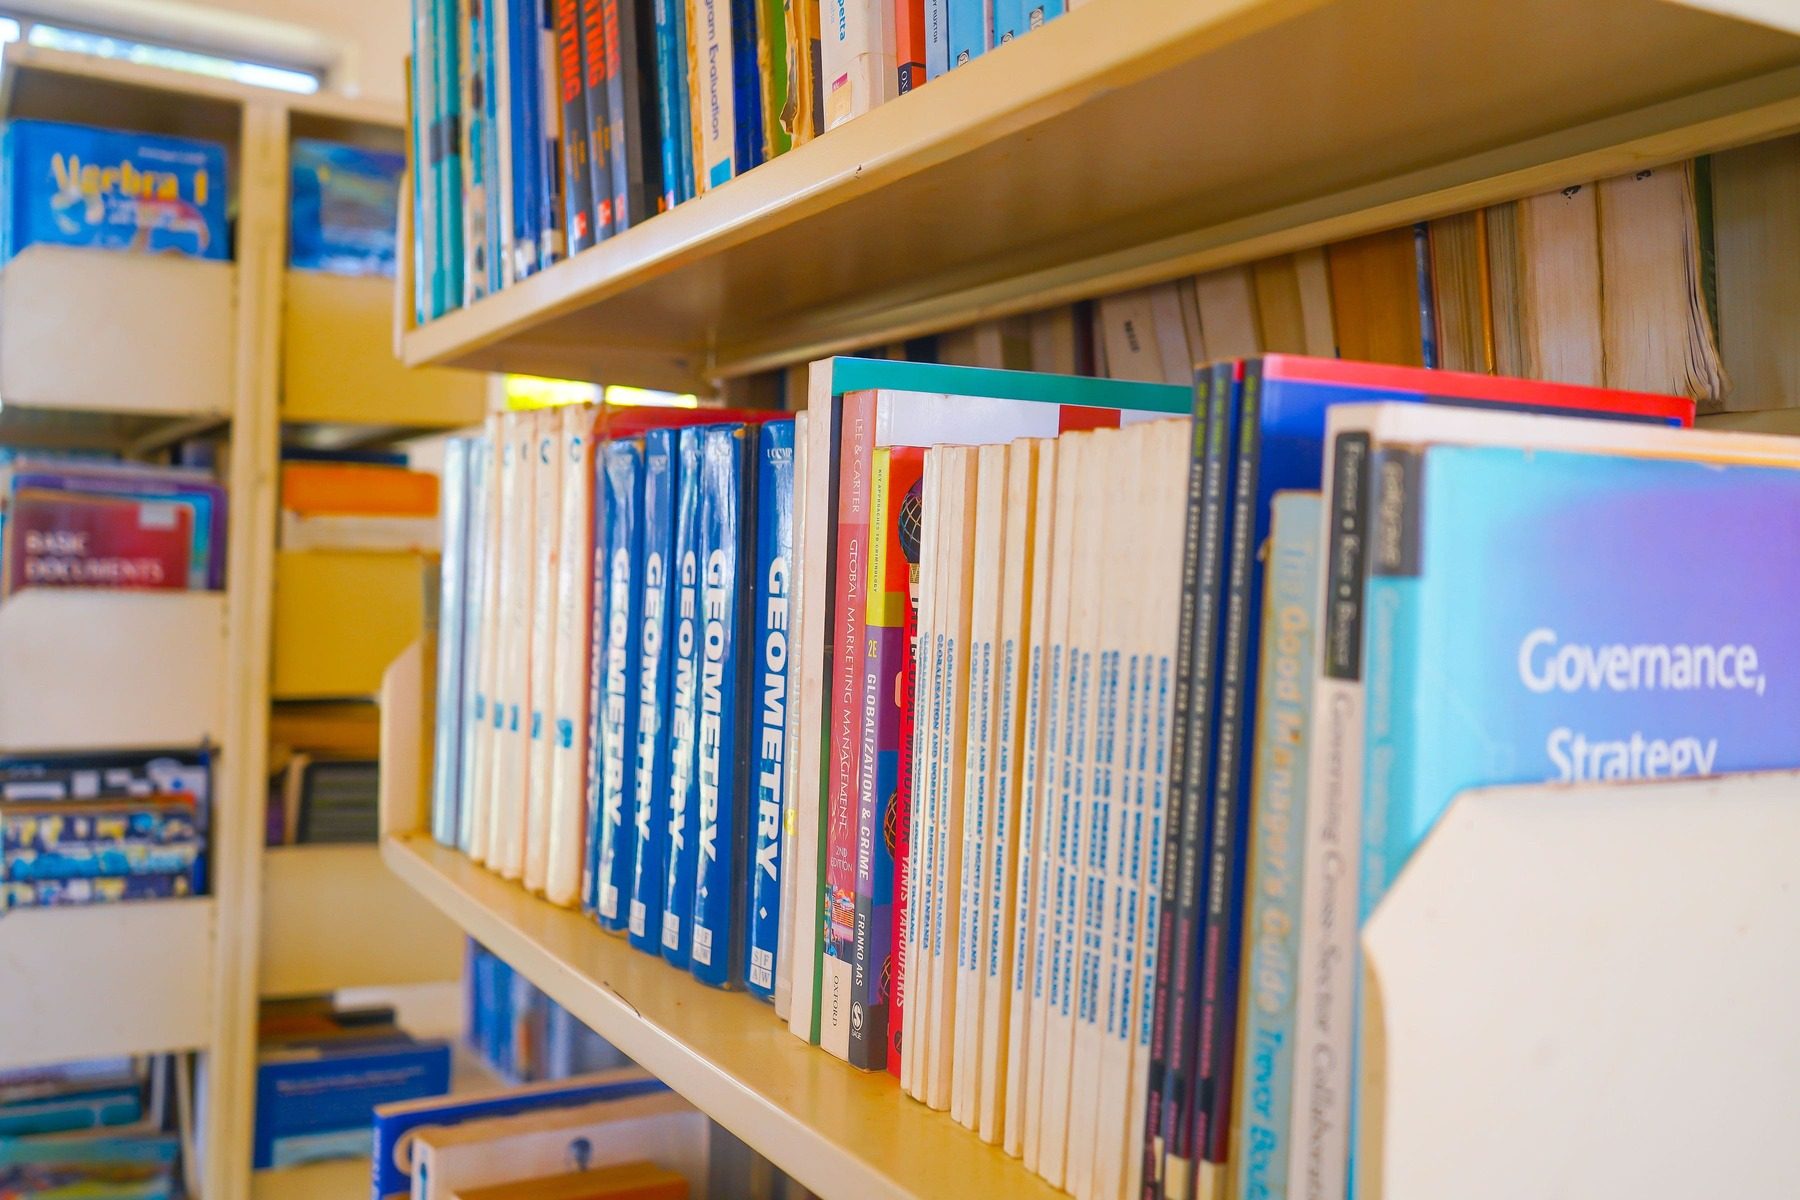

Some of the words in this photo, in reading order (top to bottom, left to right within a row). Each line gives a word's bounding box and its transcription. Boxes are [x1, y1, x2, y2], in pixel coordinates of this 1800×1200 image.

[708, 43, 720, 142] Evaluation
[854, 418, 863, 441] LEE
[854, 444, 863, 455] &
[852, 459, 862, 513] CARTER
[847, 539, 858, 601] GLOBAL
[843, 607, 856, 704] MARKETING
[867, 639, 878, 658] 2E
[1518, 627, 1767, 697] Governance,
[699, 549, 727, 862] GEOMETRY
[933, 634, 943, 729] GLOBALISATION
[756, 556, 788, 881] GEOMETRY
[862, 673, 877, 803] GLOBALIZATION
[839, 709, 852, 829] MANAGEMENT
[861, 807, 871, 820] &
[859, 826, 871, 881] CRIME
[926, 874, 931, 887] IN
[937, 880, 944, 894] IN
[974, 892, 979, 906] IN
[994, 896, 1000, 910] IN
[856, 912, 866, 961] FRANKO
[922, 893, 930, 950] TANZANIA
[935, 897, 943, 958] TANZANIA
[991, 913, 999, 976] TANZANIA
[832, 975, 840, 1027] OXFORD
[855, 963, 864, 987] AAS
